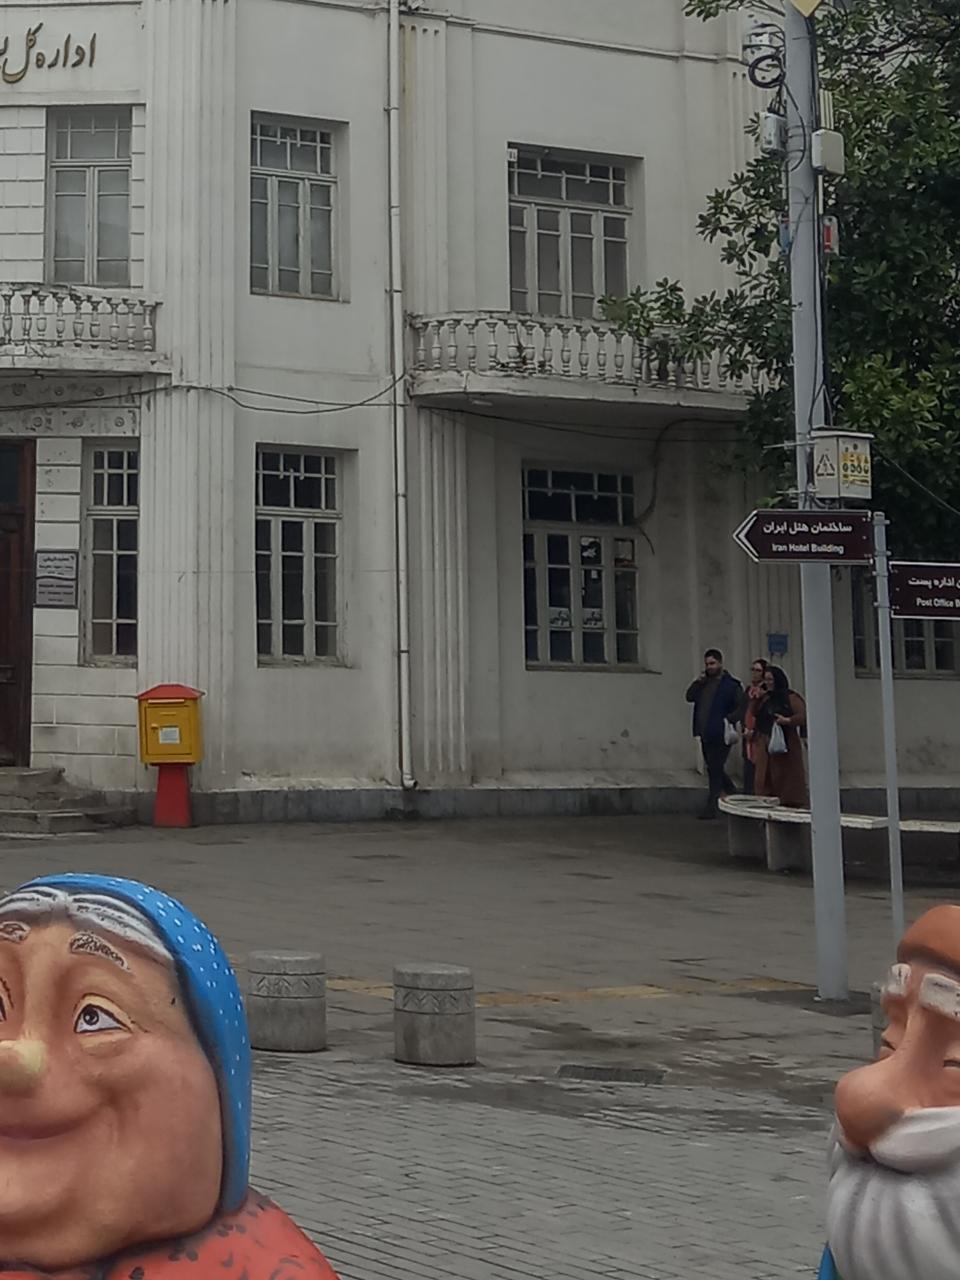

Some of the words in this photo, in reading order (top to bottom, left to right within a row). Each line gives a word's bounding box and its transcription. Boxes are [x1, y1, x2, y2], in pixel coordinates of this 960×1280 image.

[1, 21, 43, 84] کل
[35, 32, 97, 69] اداره
[763, 521, 788, 534] ایران
[788, 521, 809, 535] هتل
[810, 521, 853, 534] ساختمان
[772, 543, 788, 552] Iran
[788, 543, 810, 552] Hotel
[811, 543, 844, 555] Building
[908, 577, 932, 590] پست
[933, 576, 955, 589] اداره
[916, 597, 932, 607] Post
[933, 598, 954, 608] Office
